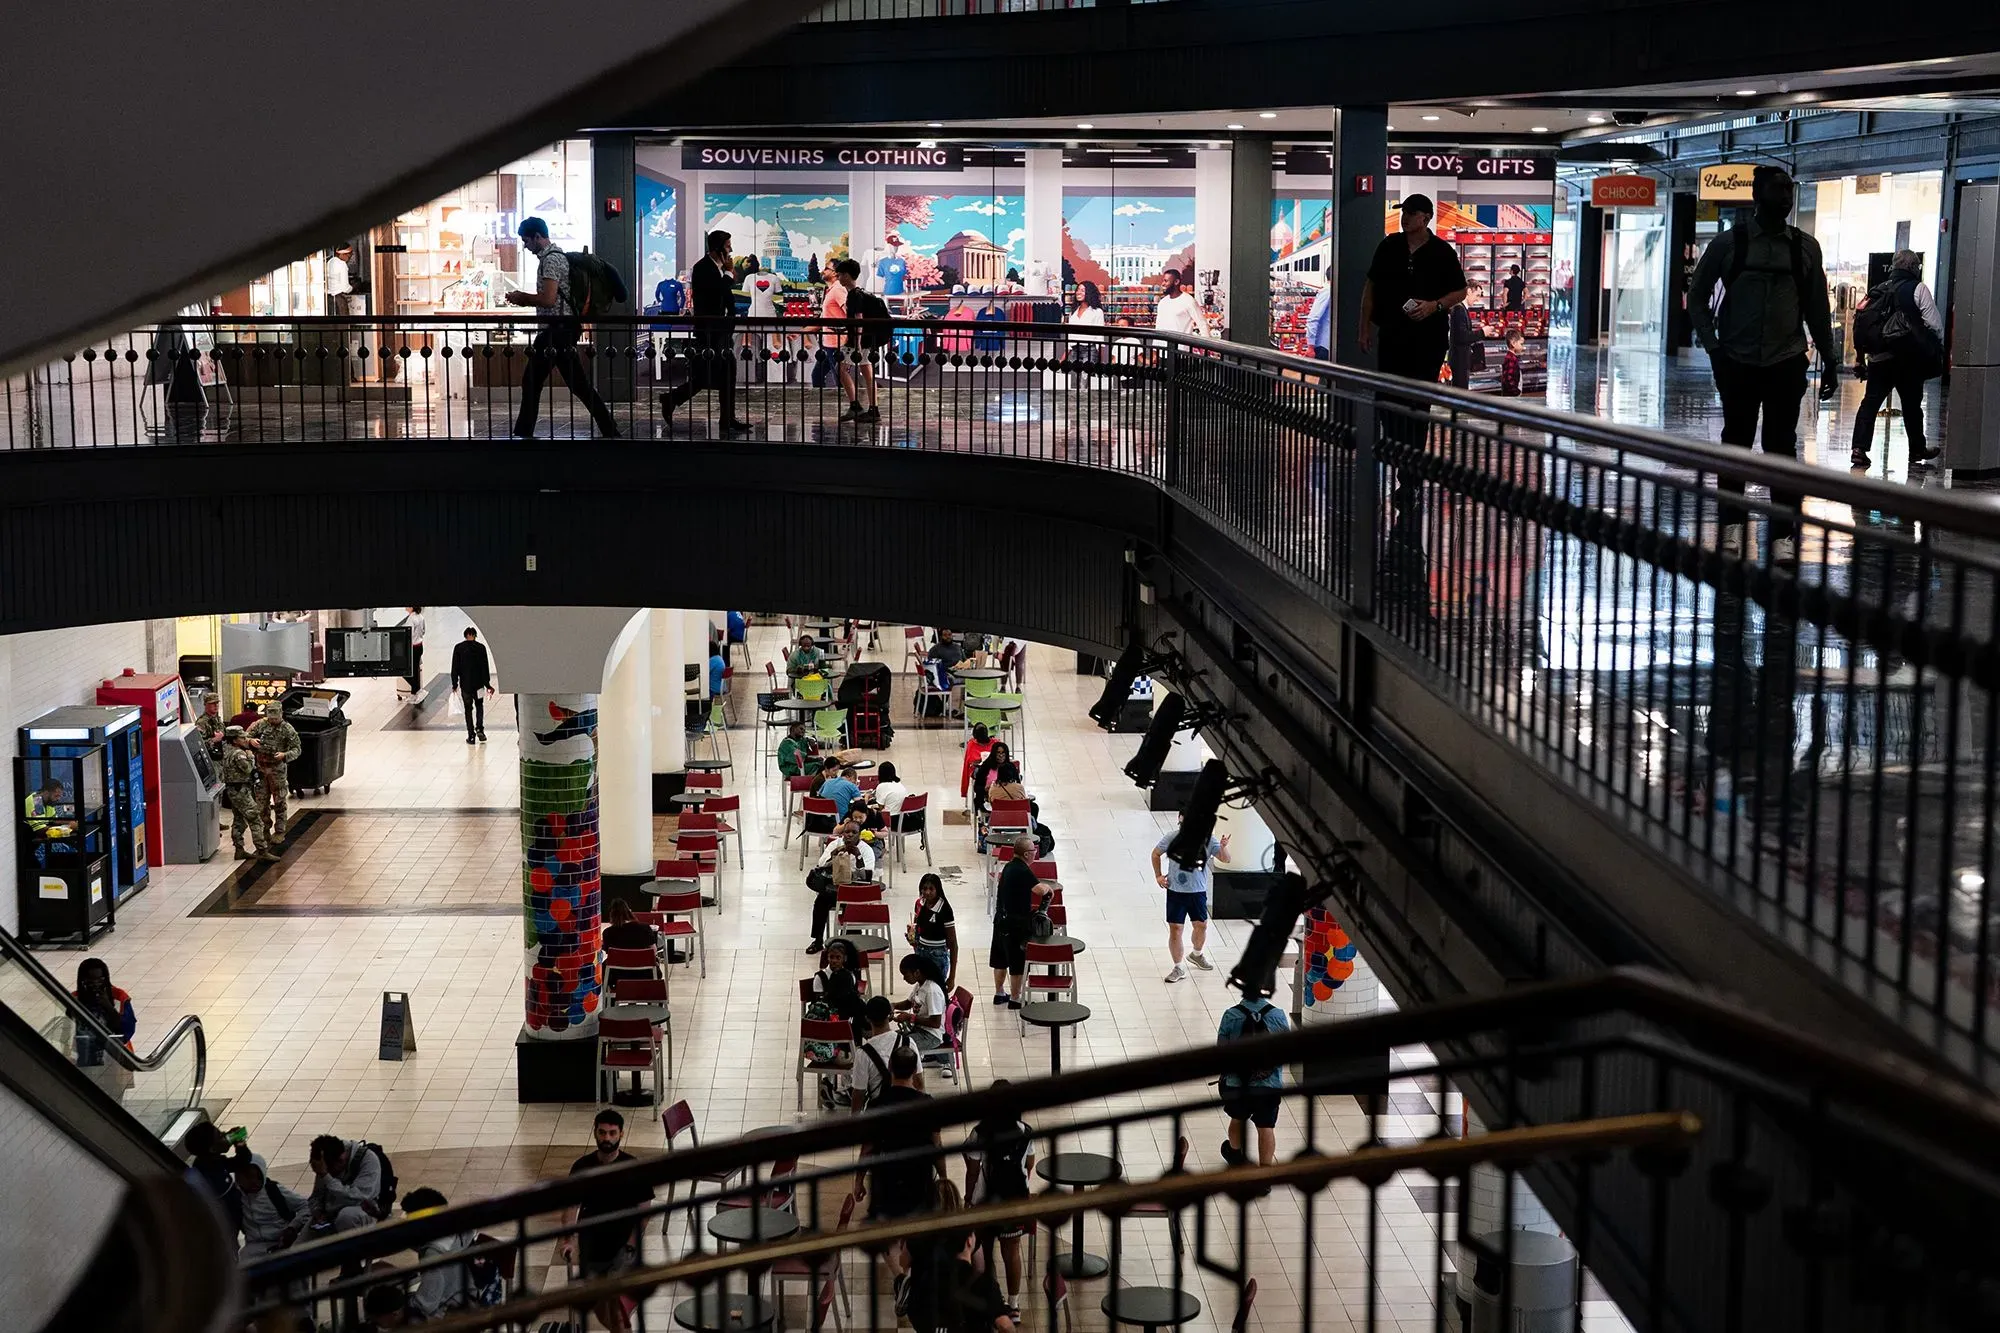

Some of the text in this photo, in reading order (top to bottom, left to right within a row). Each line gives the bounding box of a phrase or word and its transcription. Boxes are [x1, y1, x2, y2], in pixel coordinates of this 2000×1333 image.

[701, 148, 946, 165] SOUVENIRS CLOTHING
[1476, 159, 1535, 174] GIFTS
[1598, 186, 1650, 199] CHIBOO
[929, 913, 936, 923] A
